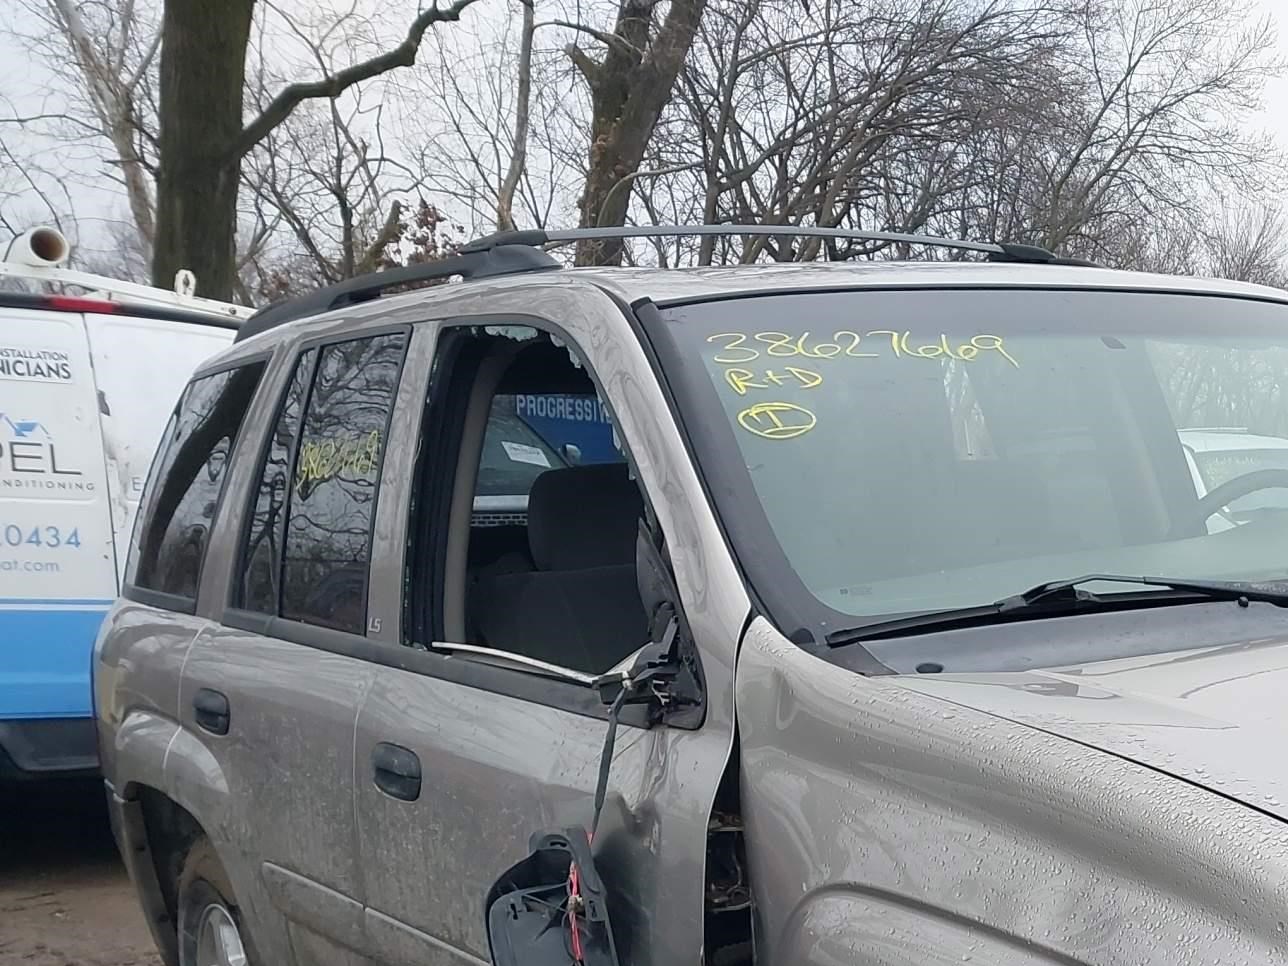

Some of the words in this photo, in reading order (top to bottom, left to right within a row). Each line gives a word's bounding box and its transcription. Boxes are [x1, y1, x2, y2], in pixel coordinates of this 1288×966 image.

[707, 330, 1019, 368] 38627669
[0, 441, 82, 475] EL
[369, 616, 381, 633] LS
